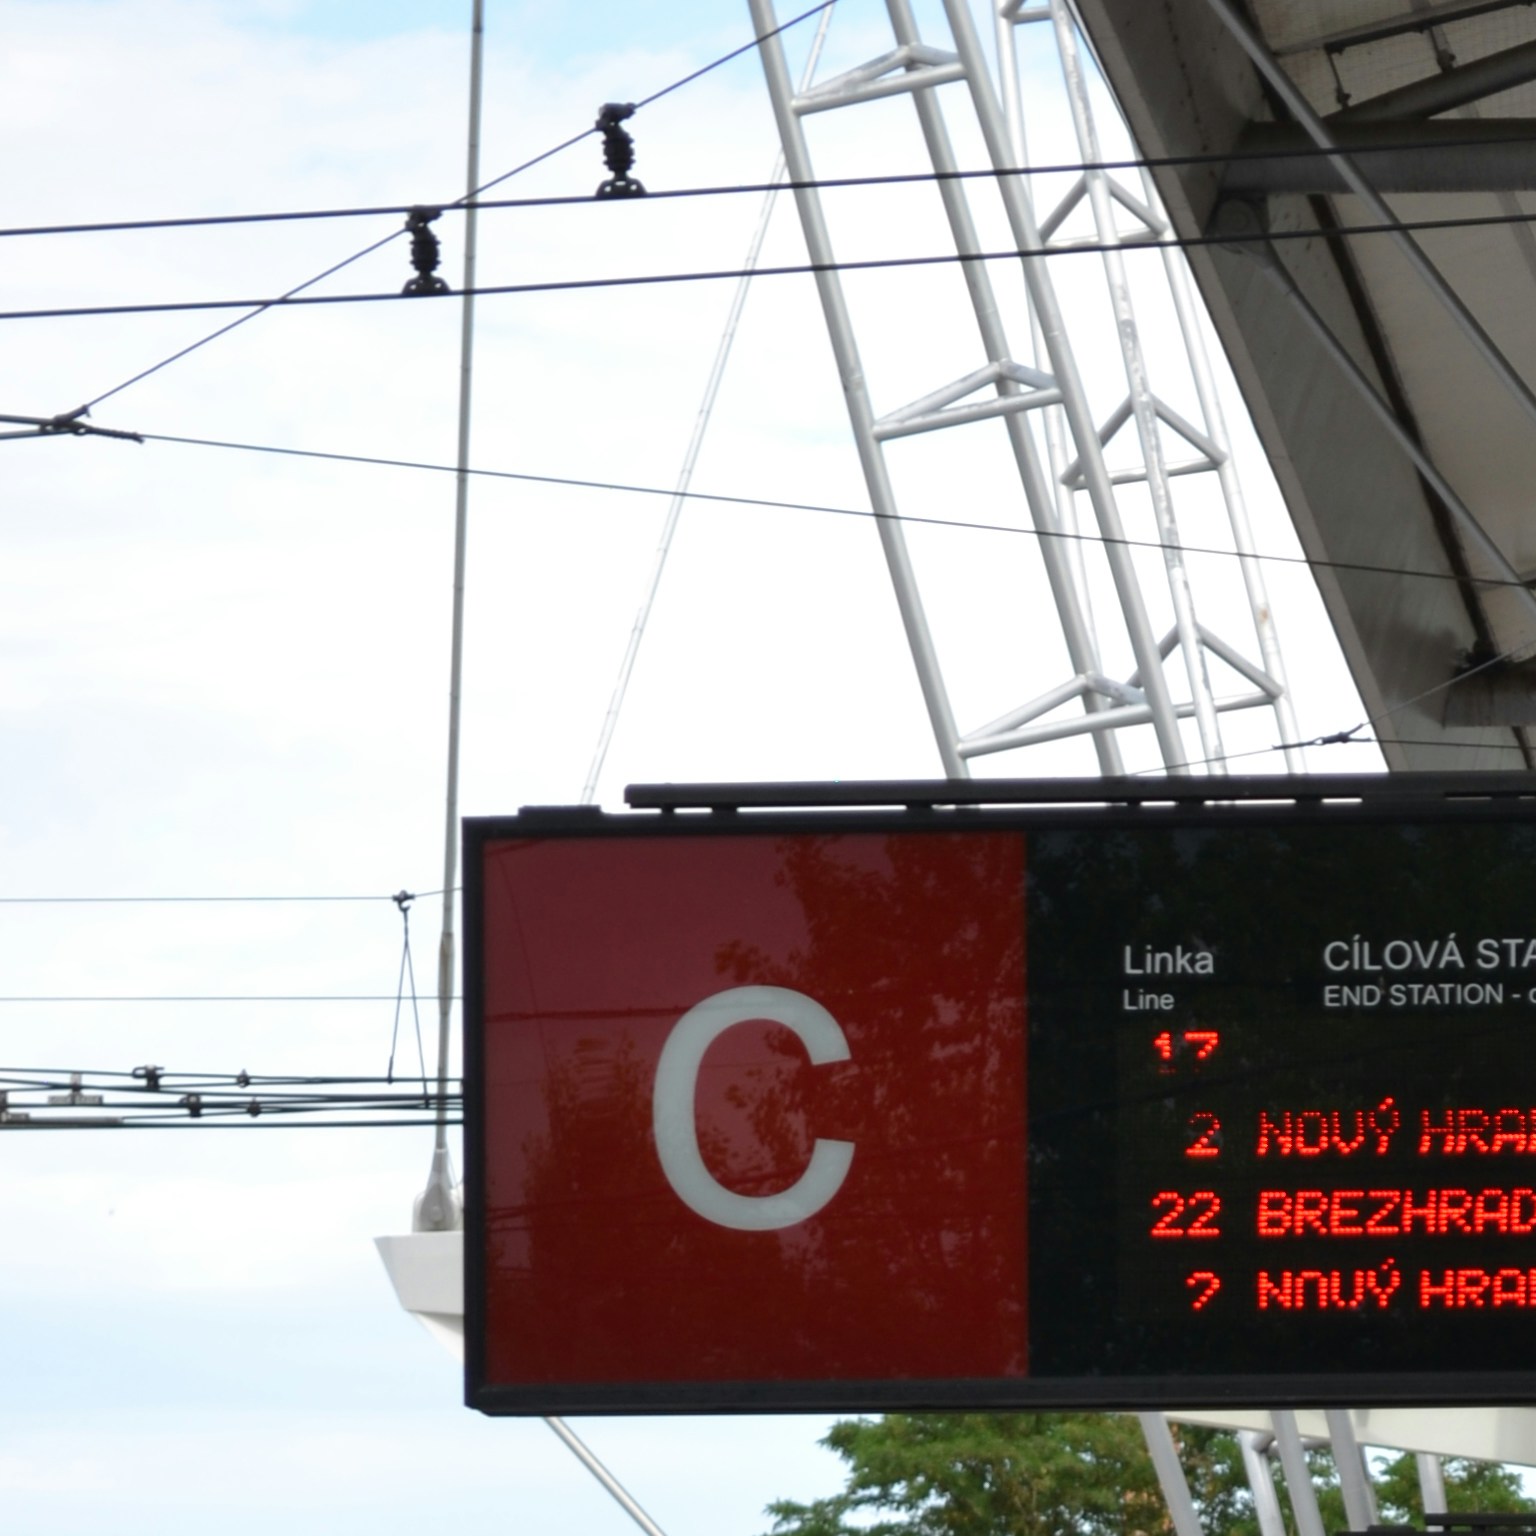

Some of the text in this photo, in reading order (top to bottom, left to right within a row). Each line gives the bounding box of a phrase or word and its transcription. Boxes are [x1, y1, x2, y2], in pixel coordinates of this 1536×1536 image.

[1123, 944, 1215, 976] Linka
[1323, 933, 1465, 972] CÍLOVÁ
[1123, 988, 1175, 1011] Line
[1323, 985, 1381, 1008] END
[1388, 984, 1503, 1006] STATION
[1153, 1031, 1220, 1073] 17
[652, 984, 856, 1232] C
[1186, 1111, 1220, 1156] 2
[1150, 1191, 1221, 1238] 22
